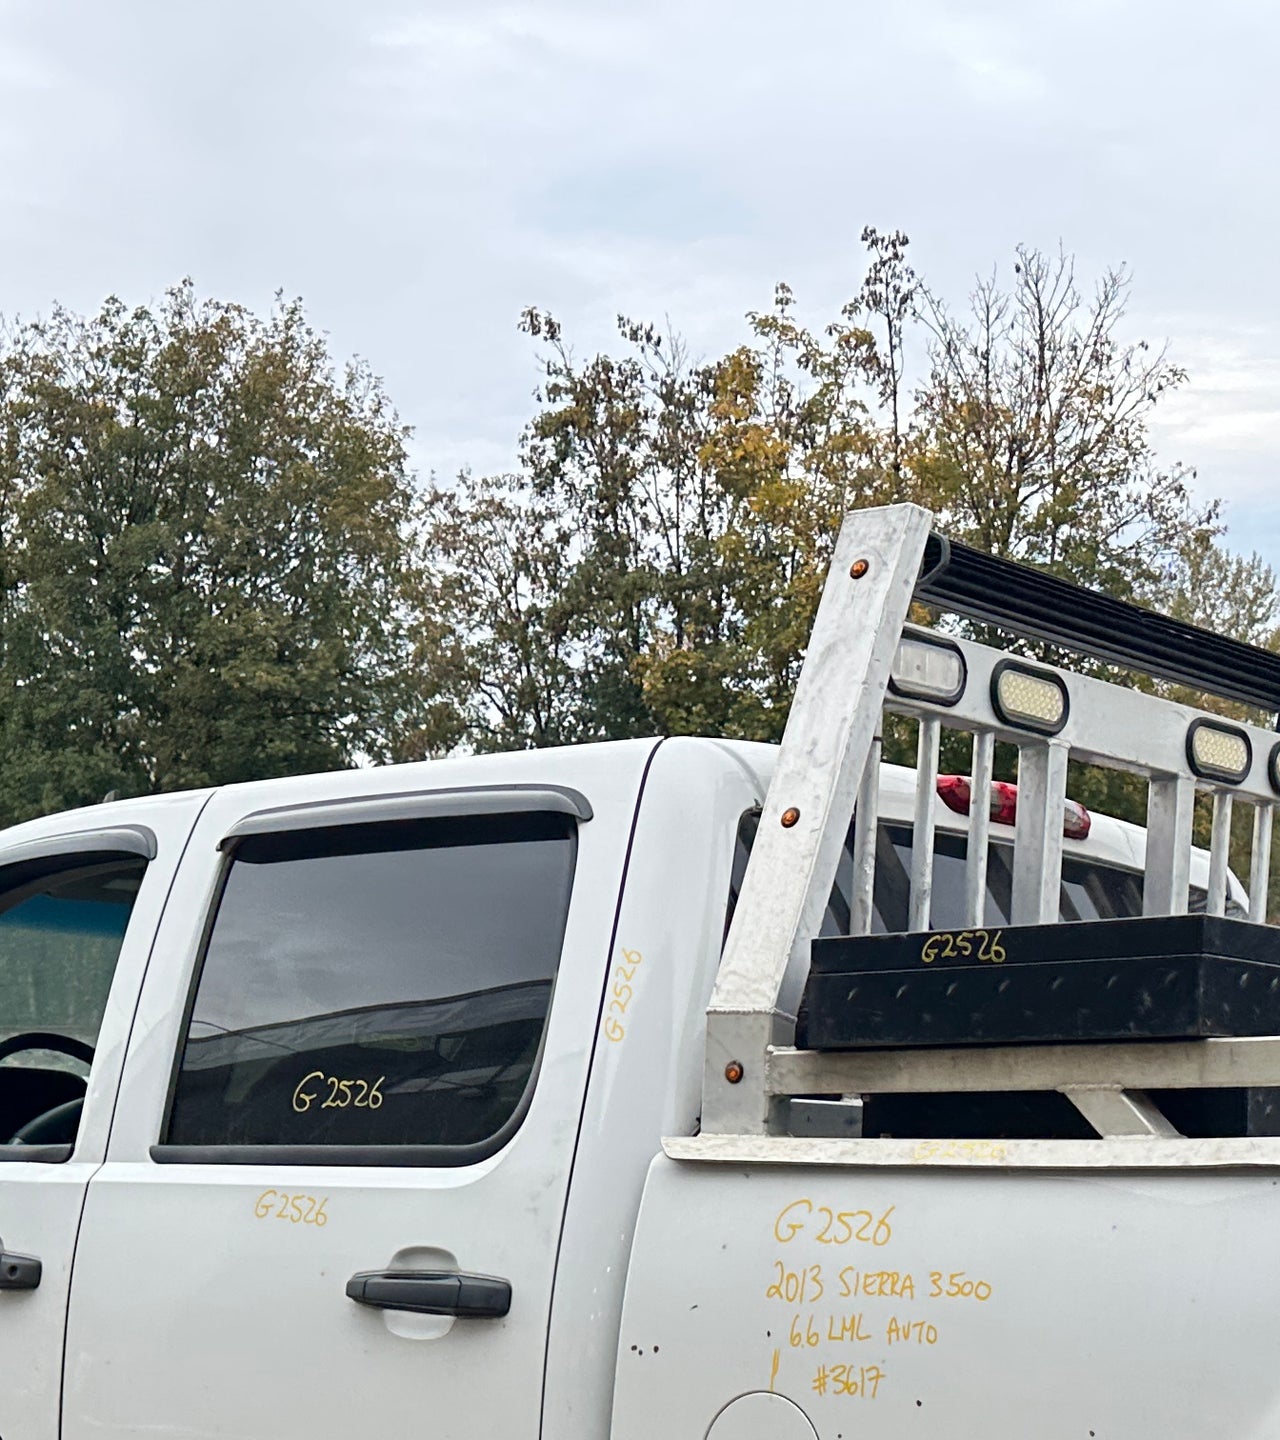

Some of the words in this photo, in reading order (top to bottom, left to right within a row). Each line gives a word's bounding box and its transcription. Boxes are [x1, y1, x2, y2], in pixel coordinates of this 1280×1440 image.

[921, 930, 1006, 963] G2526
[604, 946, 642, 1043] G2526
[293, 1071, 385, 1112] G2526
[254, 1189, 329, 1227] G2526
[766, 1260, 824, 1304] 2013
[839, 1266, 915, 1300] SIERRA
[929, 1271, 992, 1301] 3500
[790, 1314, 819, 1348] 6.6
[828, 1313, 872, 1341] LML
[812, 1364, 886, 1399] #3617
